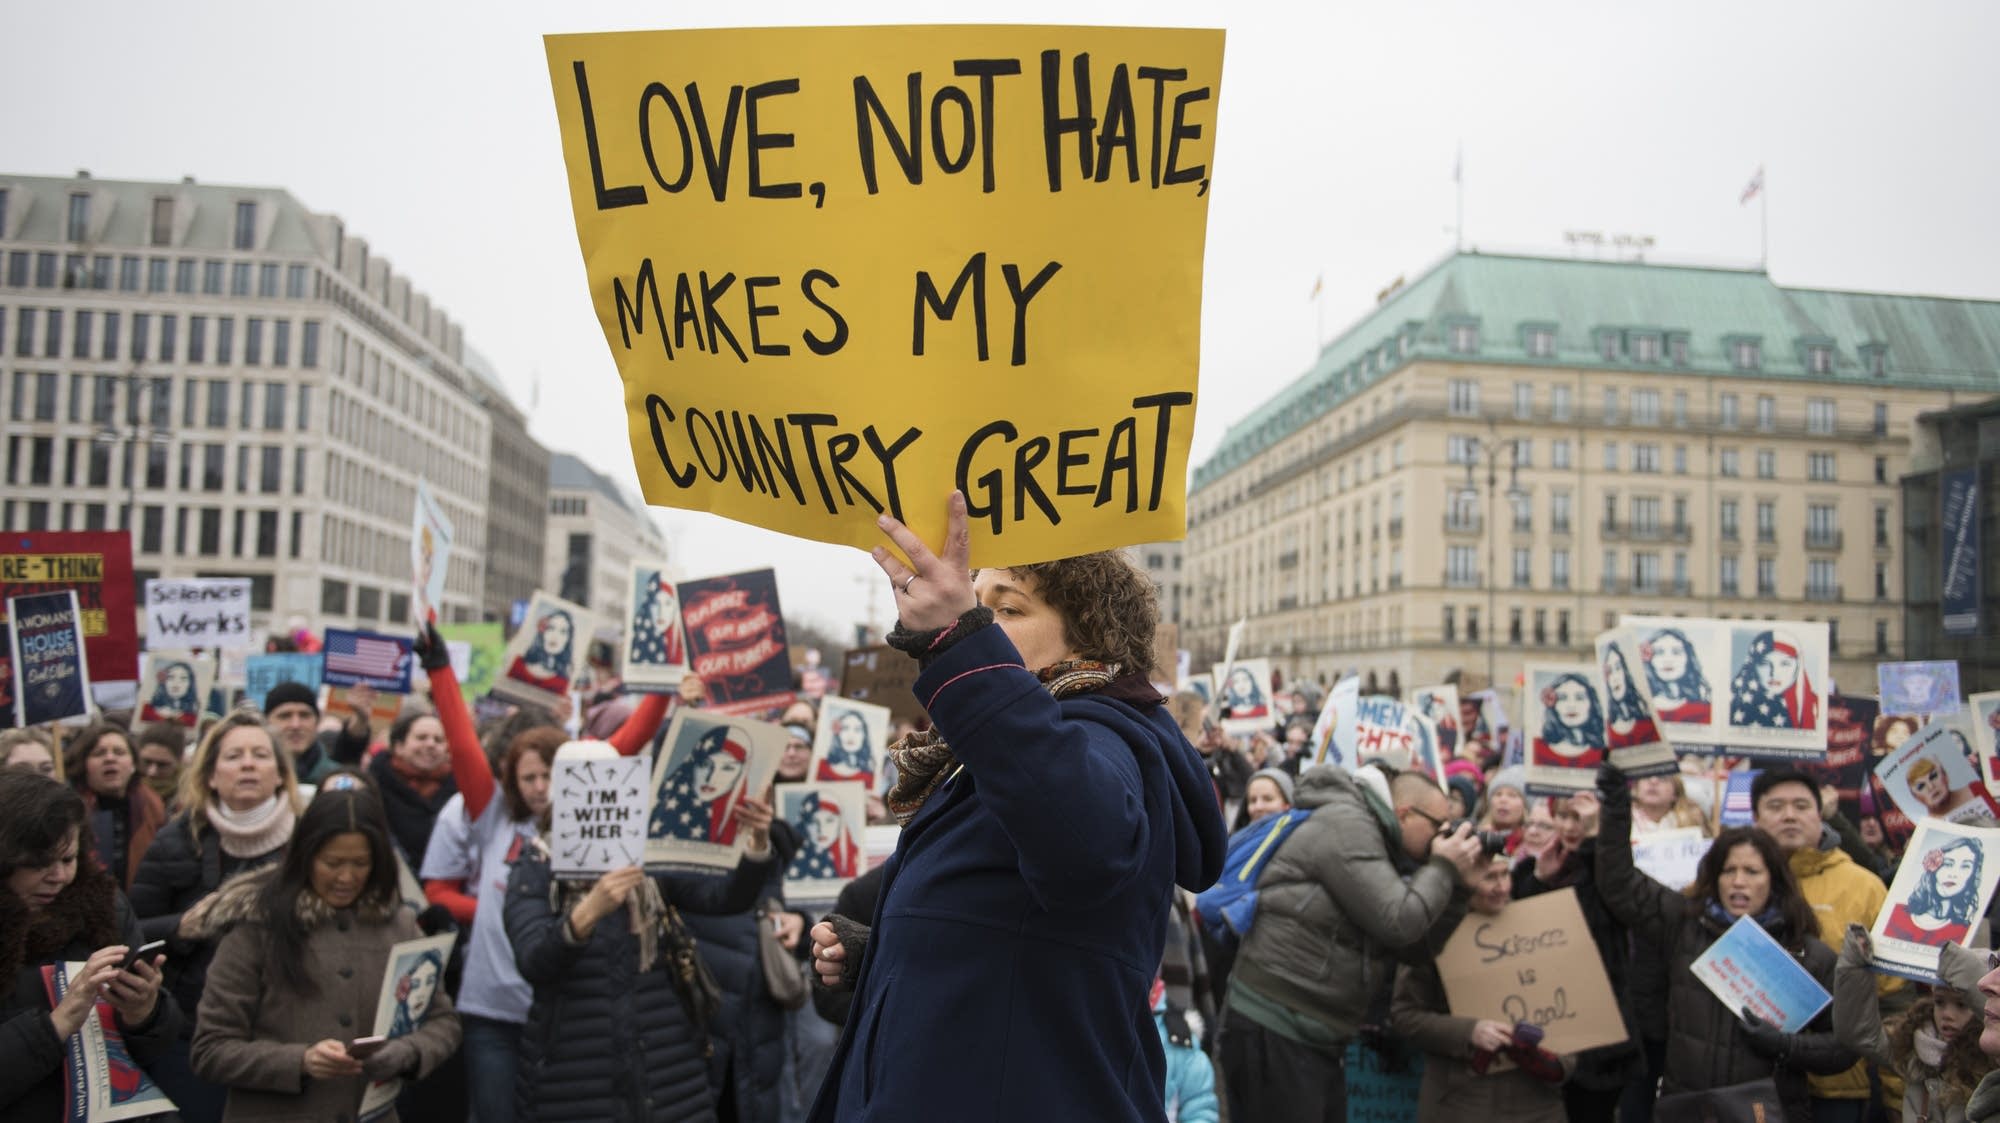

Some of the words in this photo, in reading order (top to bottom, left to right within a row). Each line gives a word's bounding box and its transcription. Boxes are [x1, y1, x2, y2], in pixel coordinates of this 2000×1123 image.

[573, 61, 826, 210] LOVE,
[853, 59, 1021, 195] NOT
[1040, 49, 1210, 197] HATE,
[614, 258, 849, 362] MAKES
[913, 252, 1062, 366] MY
[645, 394, 922, 525] COUNTRY
[955, 392, 1193, 535] GREAT
[152, 585, 243, 604] Science
[156, 611, 245, 636] Works
[23, 628, 73, 654] HOUSE
[587, 789, 617, 805] I'M
[574, 807, 629, 822] WITH
[580, 825, 622, 839] HER
[1474, 923, 1568, 963] Science
